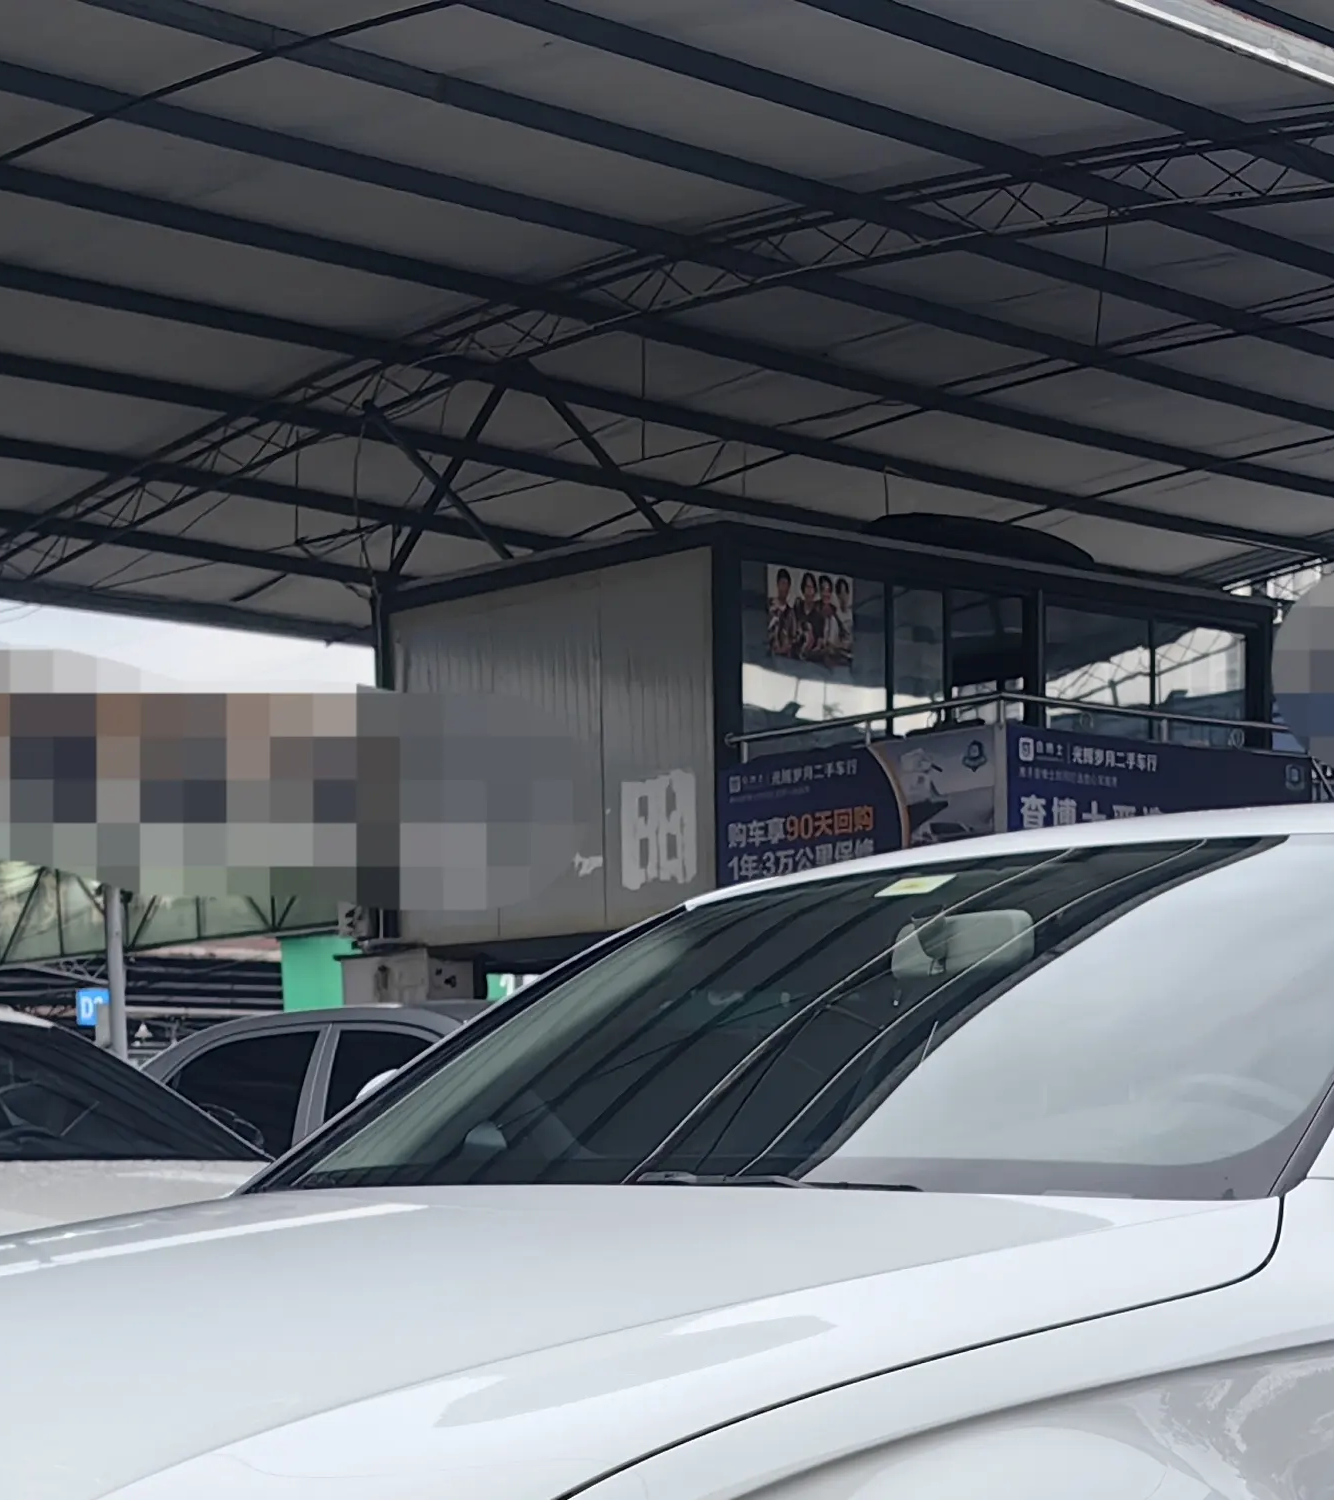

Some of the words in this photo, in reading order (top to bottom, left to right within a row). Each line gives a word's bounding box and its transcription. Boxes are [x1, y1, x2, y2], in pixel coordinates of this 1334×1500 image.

[727, 804, 874, 849] 购车享90天回购
